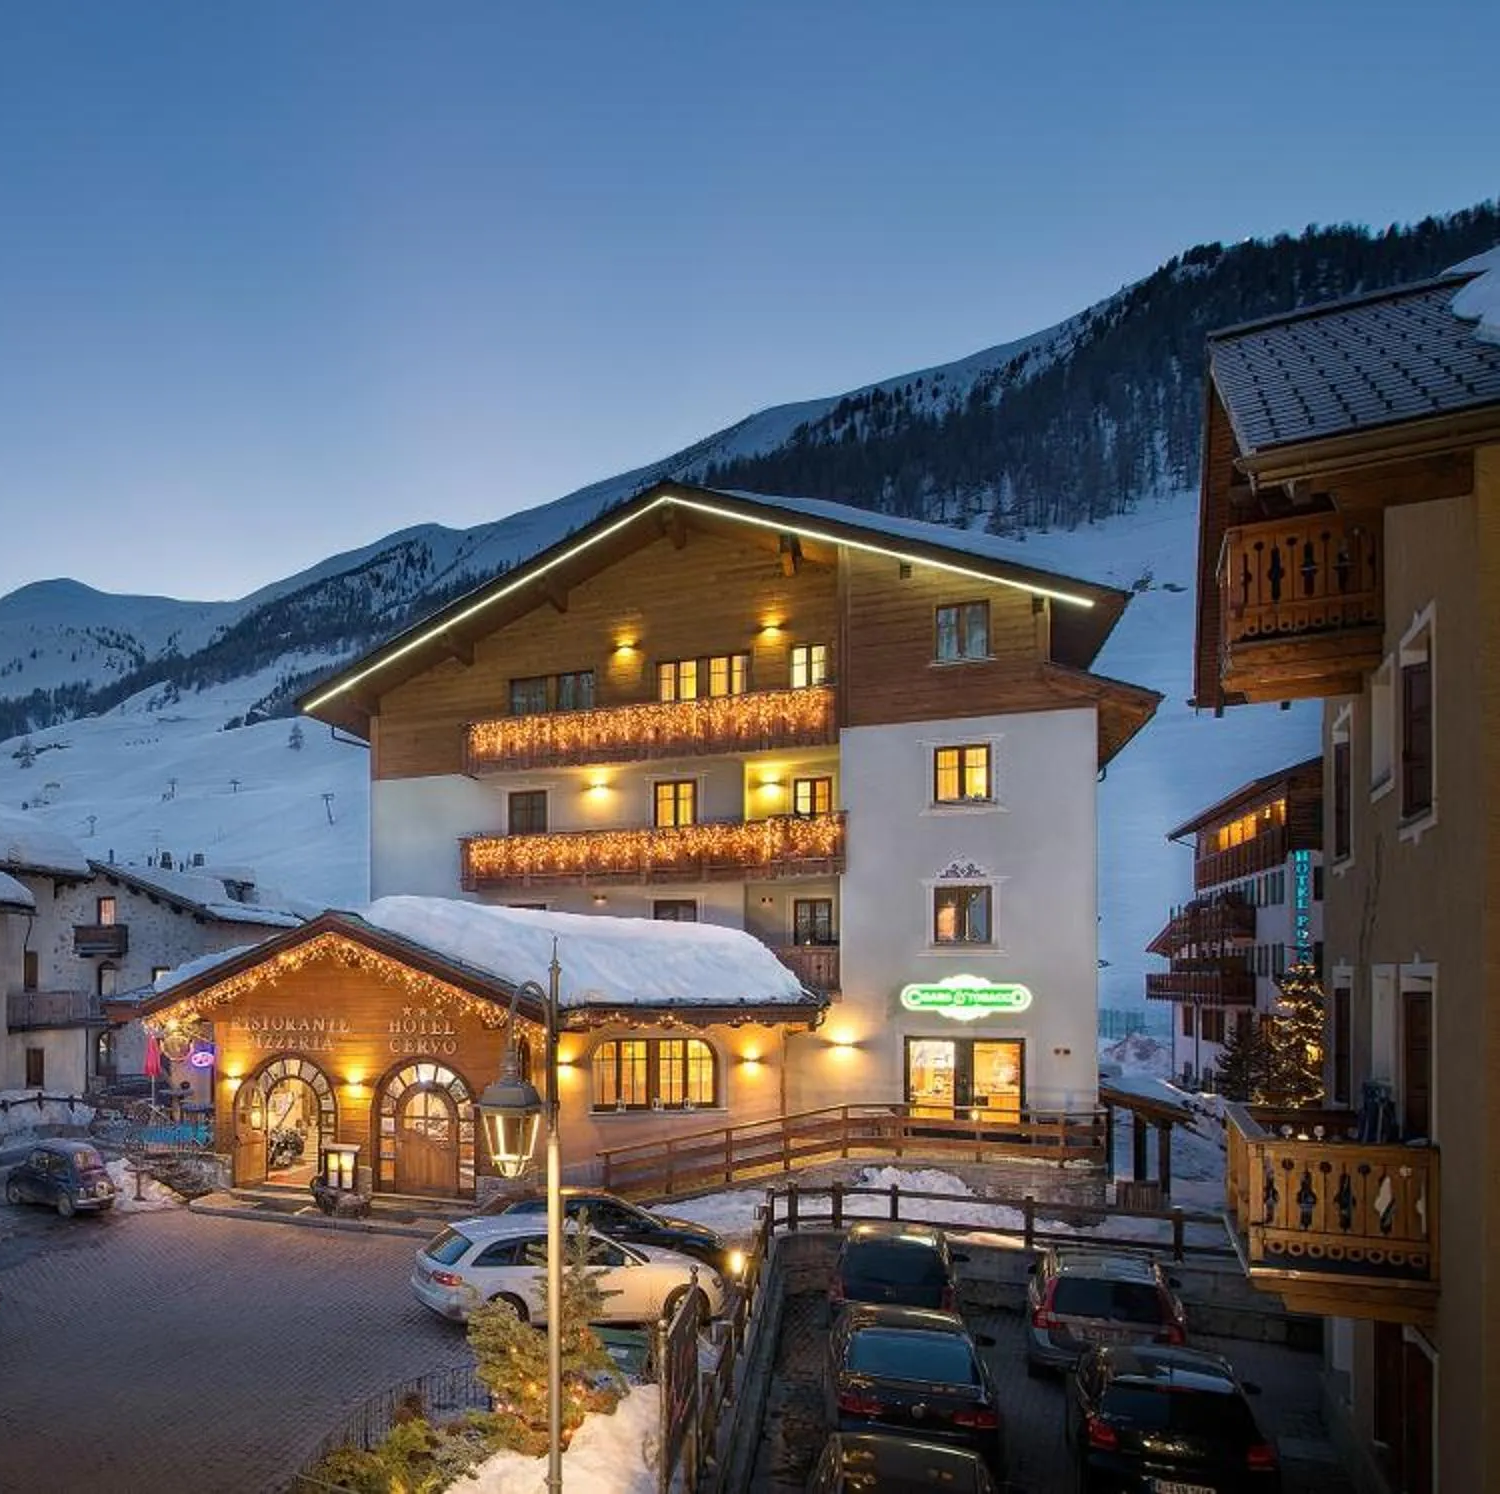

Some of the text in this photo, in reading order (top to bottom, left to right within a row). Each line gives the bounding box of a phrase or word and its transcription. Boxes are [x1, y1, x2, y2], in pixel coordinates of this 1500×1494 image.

[1295, 849, 1308, 909] HOTEL
[388, 1019, 455, 1035] HOTEL
[388, 1038, 457, 1055] CERVO
